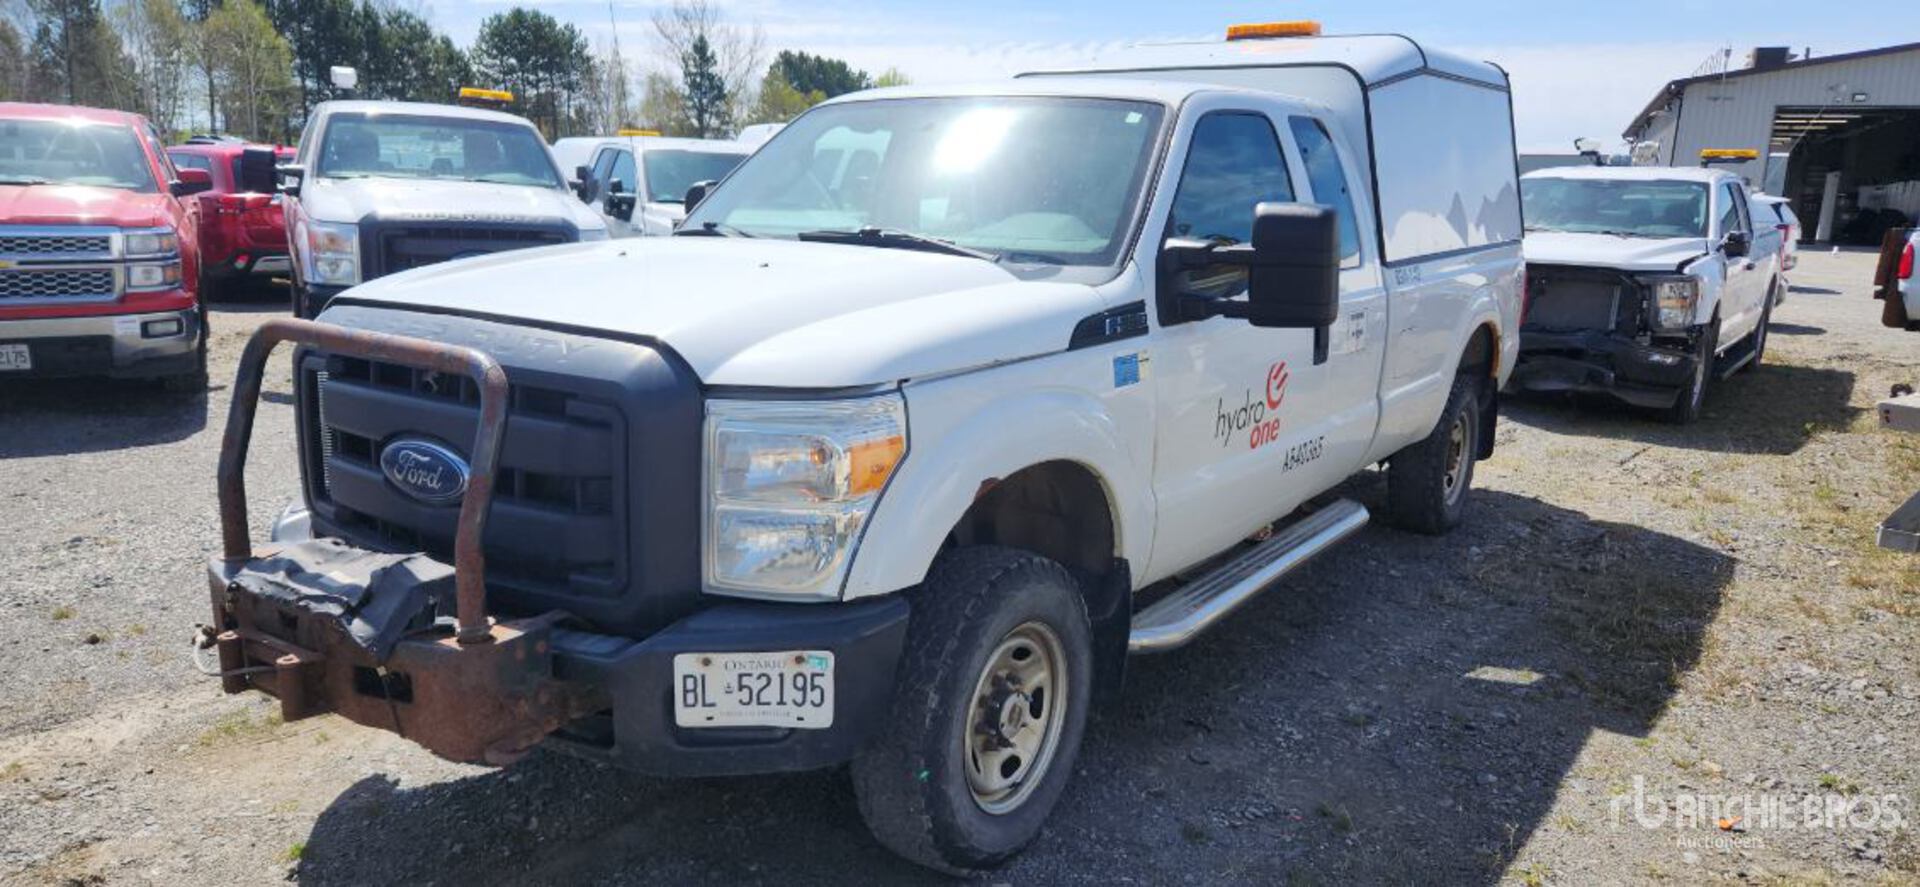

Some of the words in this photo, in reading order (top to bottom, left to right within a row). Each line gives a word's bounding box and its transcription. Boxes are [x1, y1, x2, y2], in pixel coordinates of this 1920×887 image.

[1214, 387, 1265, 448] hydro
[1250, 418, 1280, 449] one
[394, 449, 443, 490] Ford
[682, 673, 717, 708] BL
[737, 672, 826, 708] 52195
